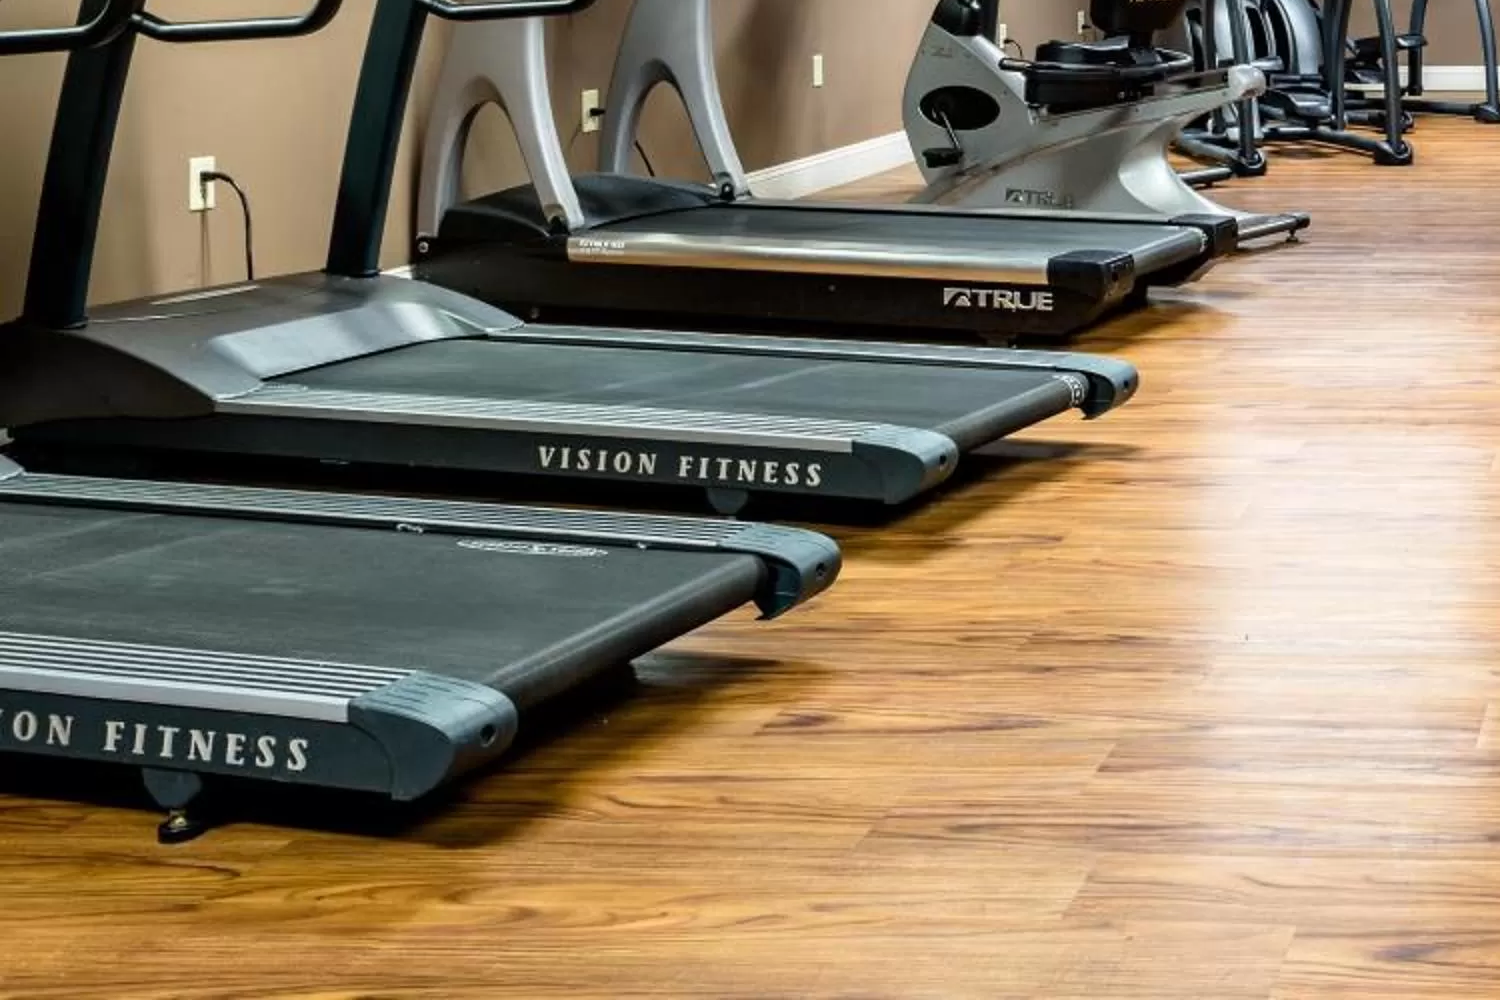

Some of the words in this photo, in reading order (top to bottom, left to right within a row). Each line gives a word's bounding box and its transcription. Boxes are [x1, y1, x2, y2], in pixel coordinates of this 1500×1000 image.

[971, 288, 1054, 312] TRUE
[538, 445, 658, 475] VISION
[678, 455, 822, 487] FITNESS
[0, 708, 74, 747] ON
[103, 720, 309, 772] FITNESS
